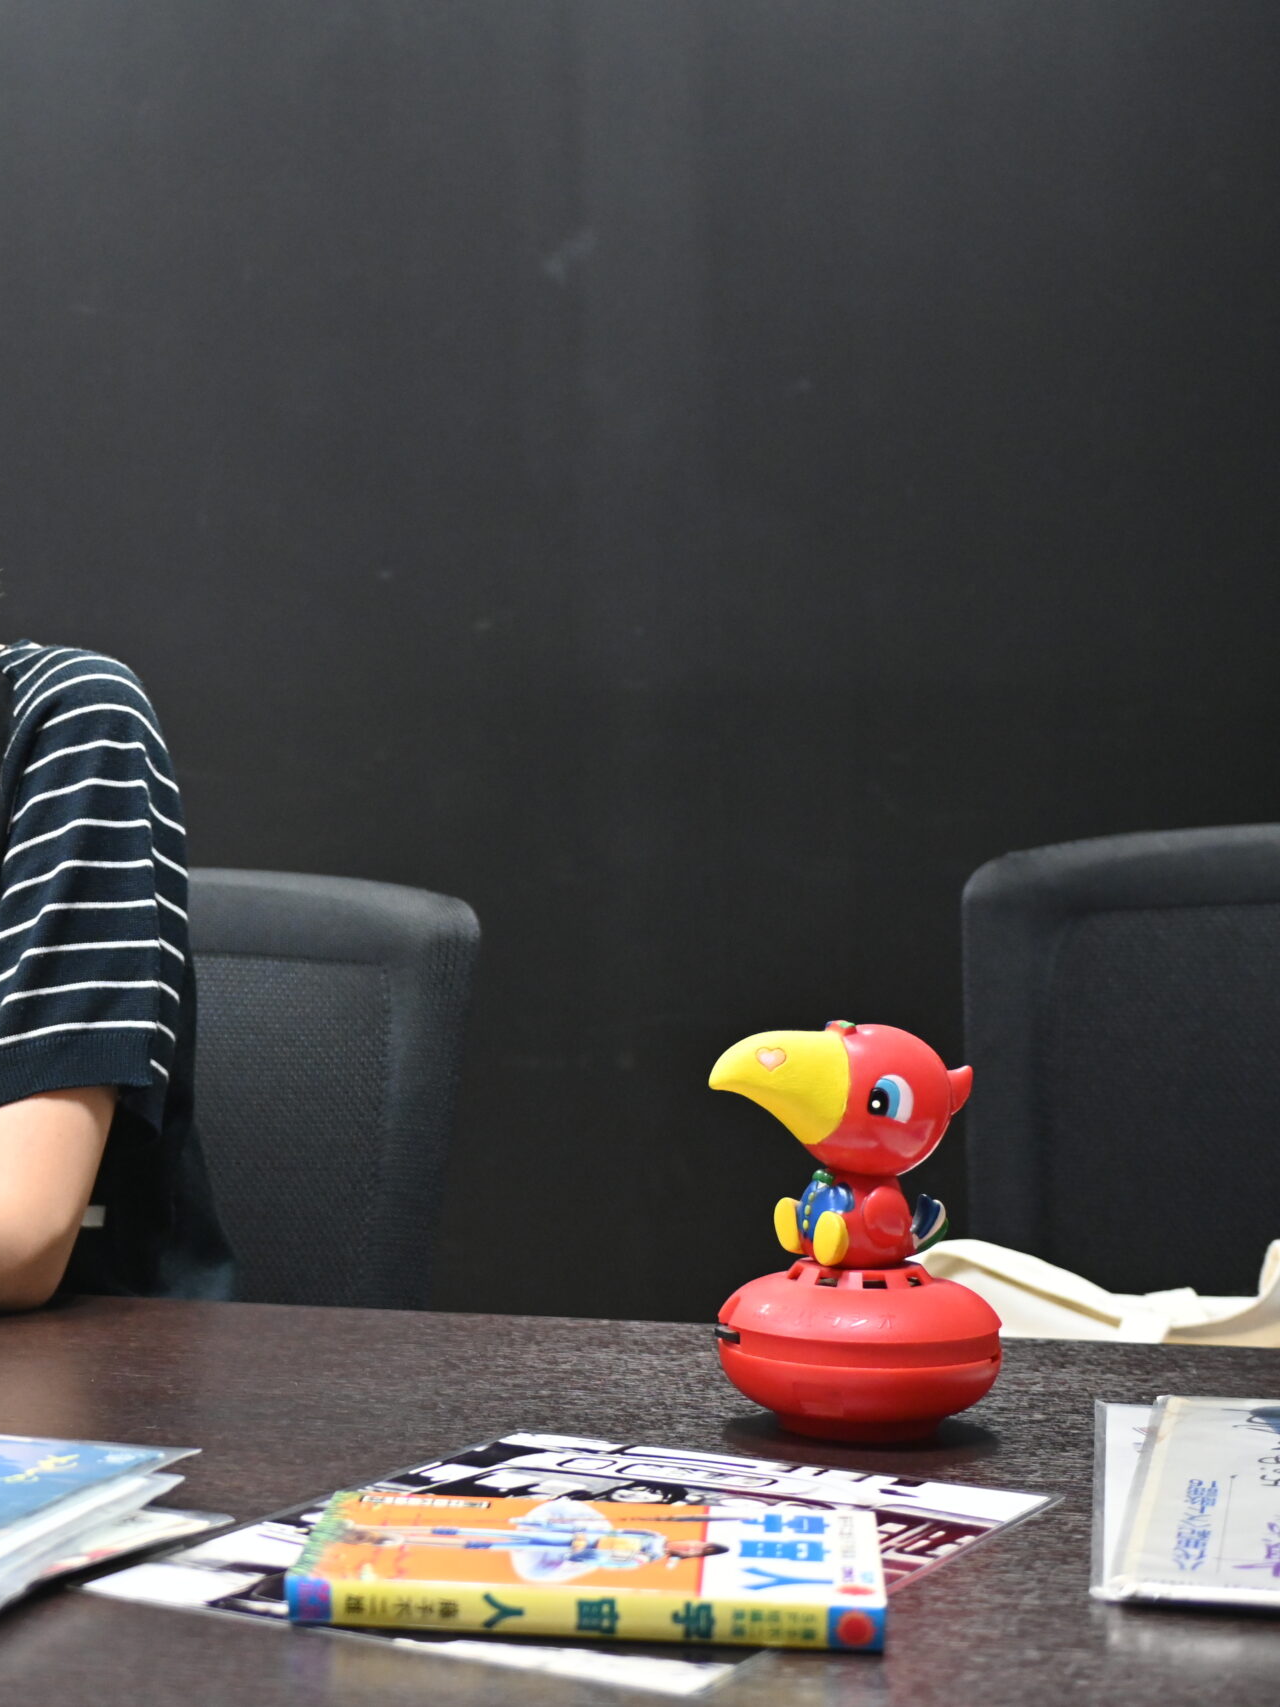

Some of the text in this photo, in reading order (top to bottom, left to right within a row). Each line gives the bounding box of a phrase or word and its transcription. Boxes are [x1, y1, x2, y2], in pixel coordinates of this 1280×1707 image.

[739, 1514, 833, 1591] 宇宙人
[484, 1593, 715, 1641] 宇宙人
